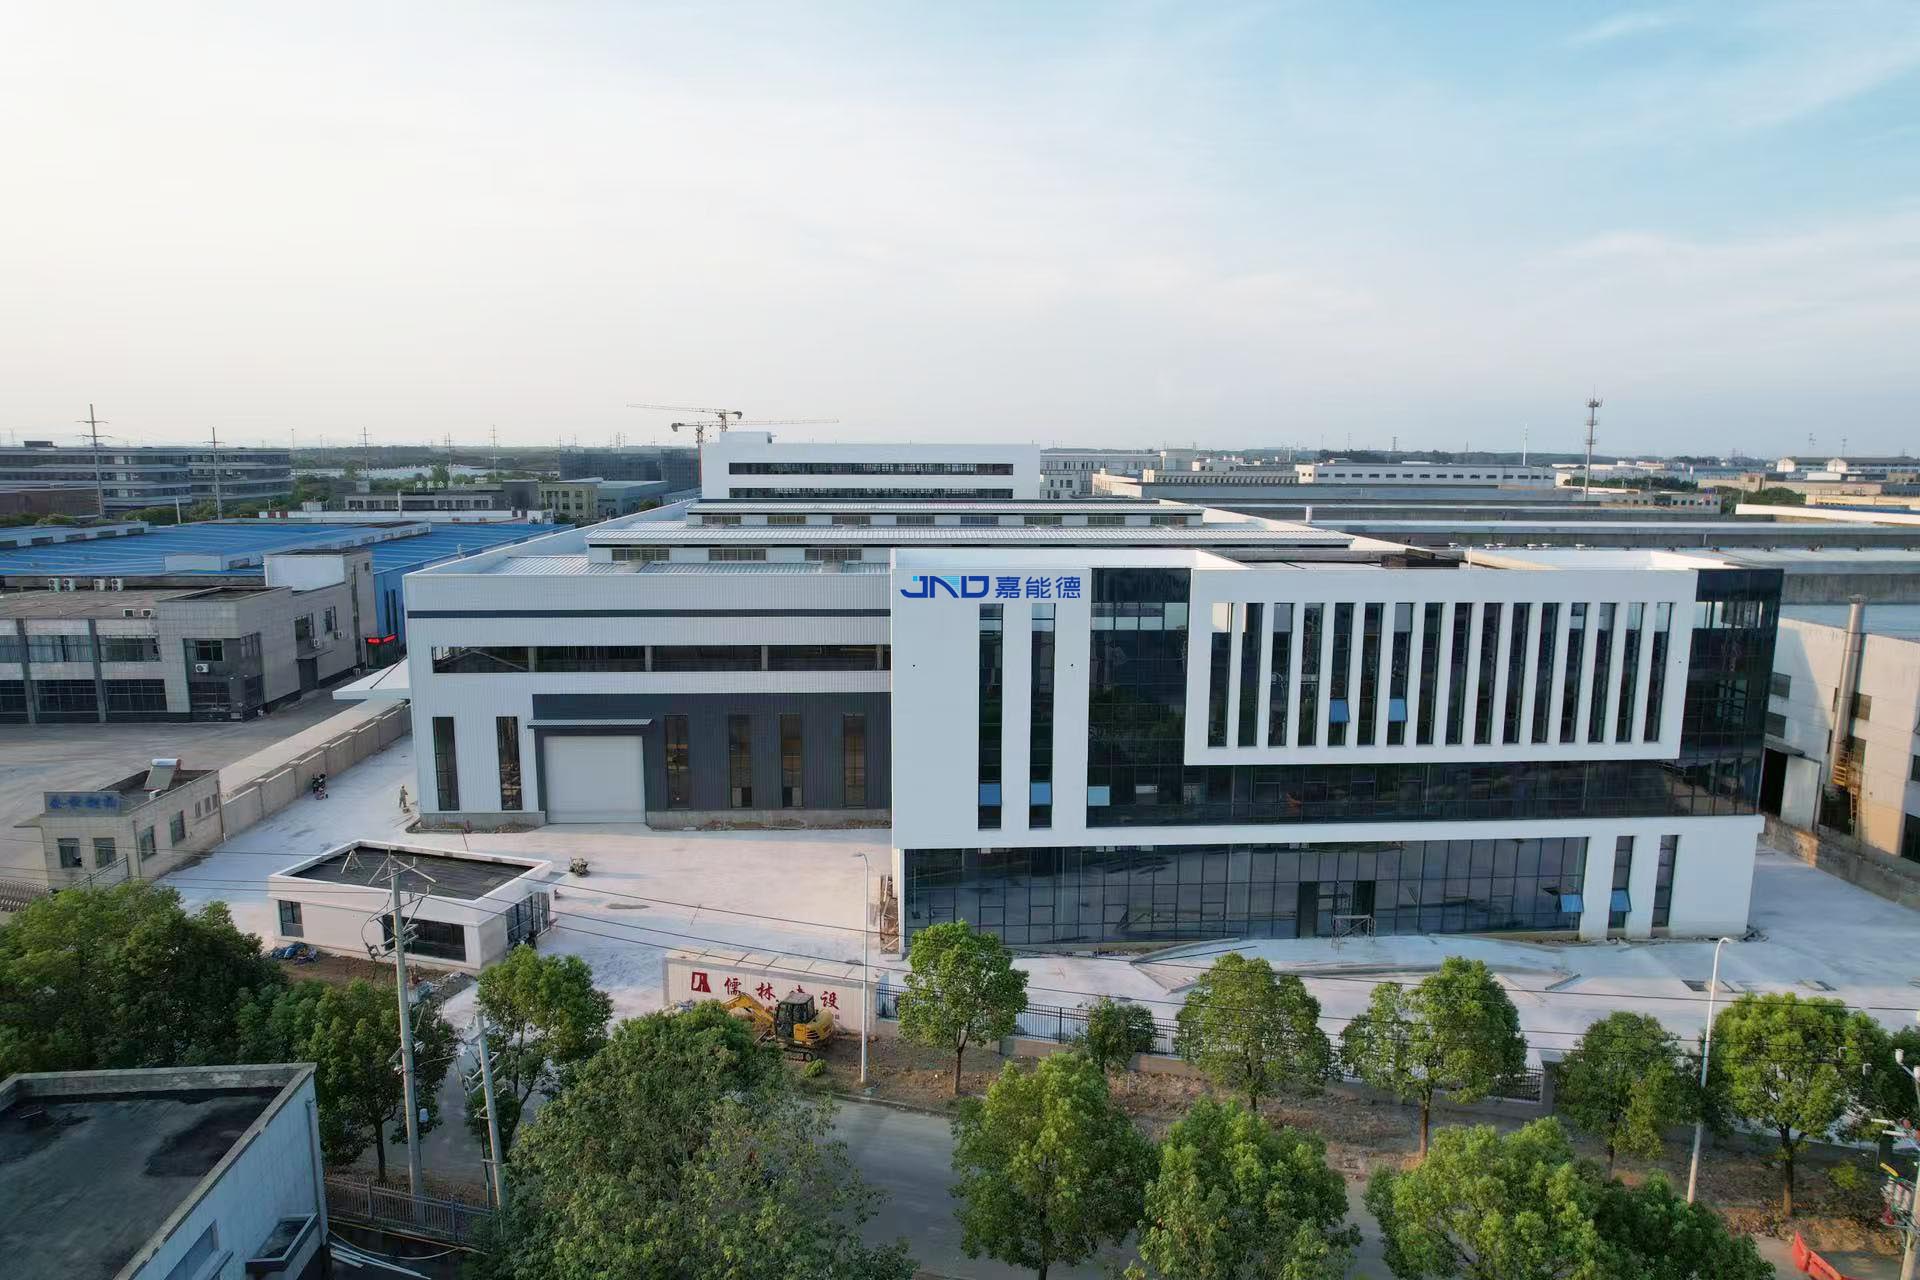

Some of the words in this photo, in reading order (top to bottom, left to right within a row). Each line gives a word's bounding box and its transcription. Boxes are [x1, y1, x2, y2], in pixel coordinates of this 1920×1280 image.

[900, 576, 989, 598] JND
[995, 576, 1081, 599] 嘉能德
